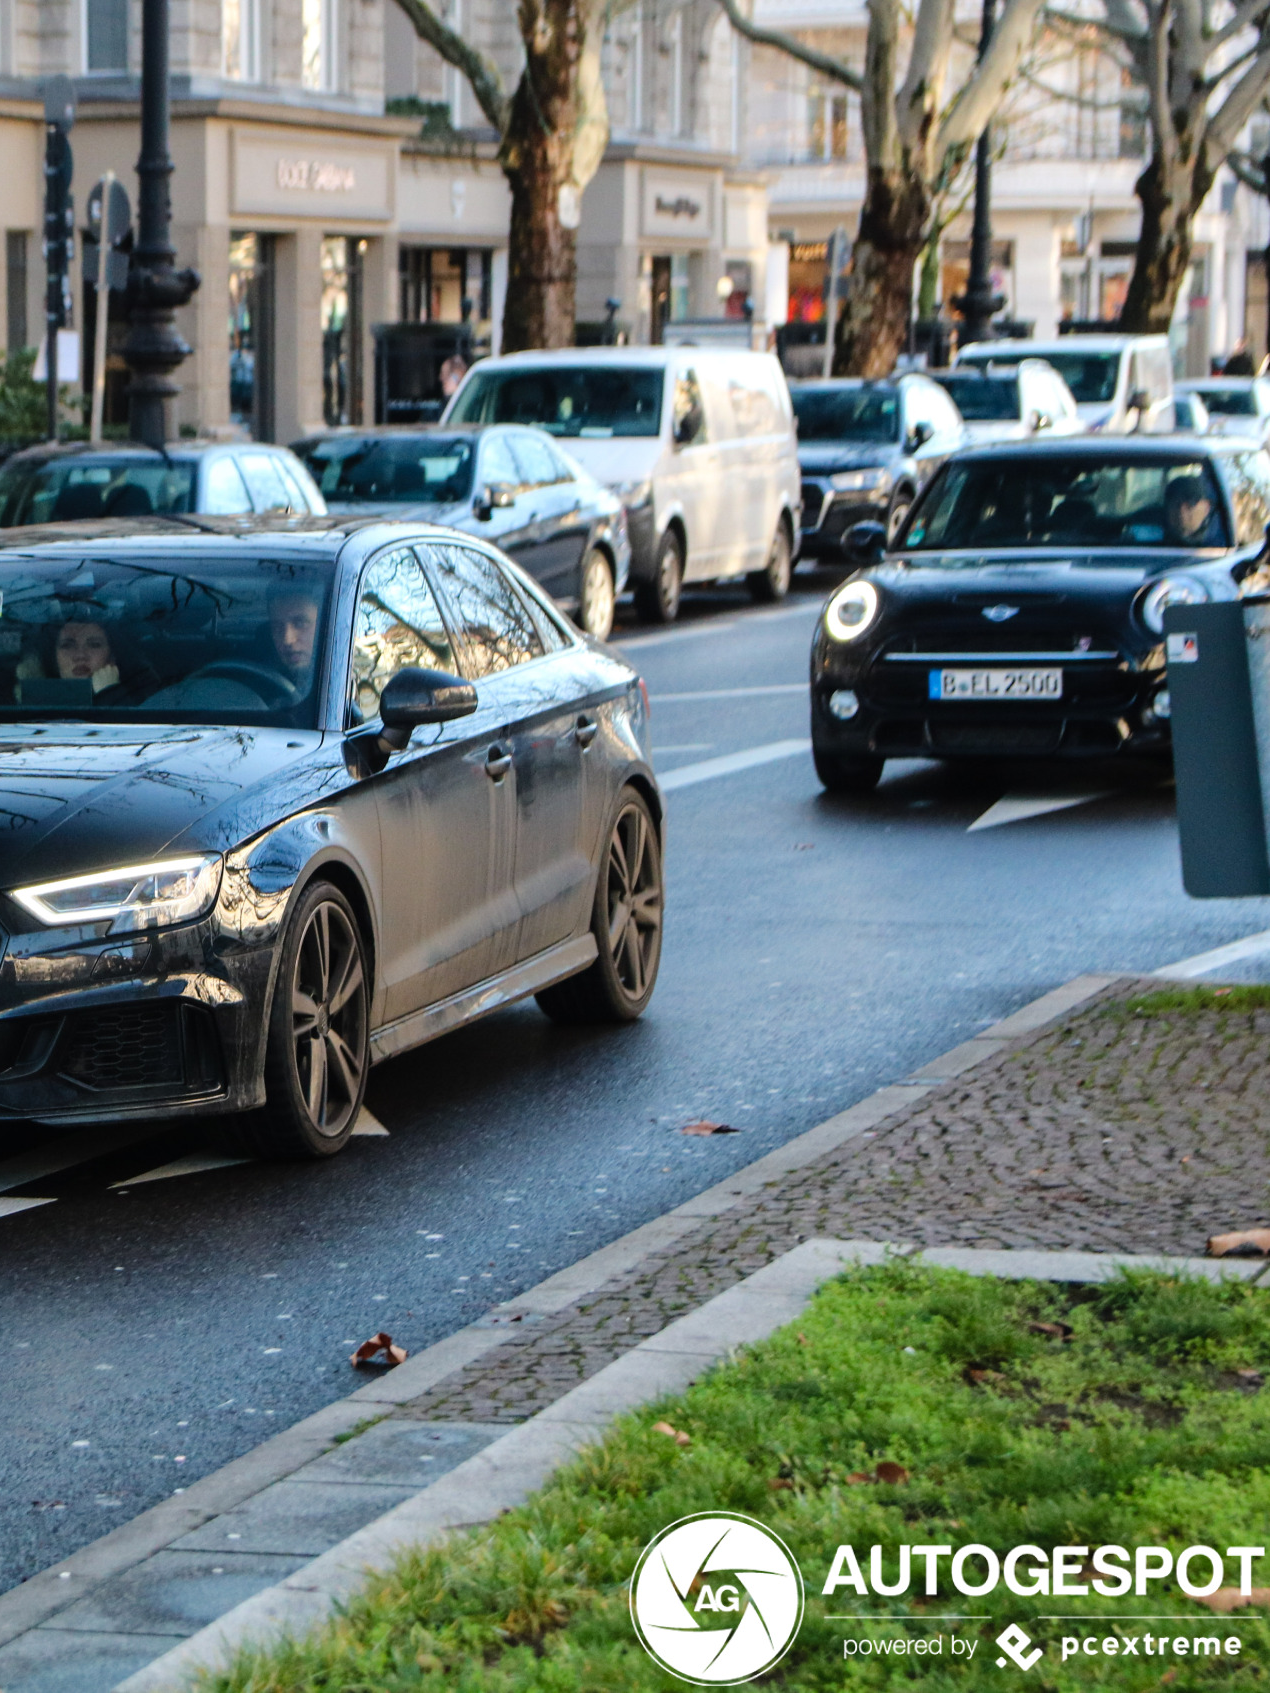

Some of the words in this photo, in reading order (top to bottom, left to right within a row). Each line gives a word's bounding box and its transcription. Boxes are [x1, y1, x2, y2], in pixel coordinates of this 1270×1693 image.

[943, 673, 956, 695] B
[971, 673, 999, 695] EL
[1004, 673, 1059, 695] 2500
